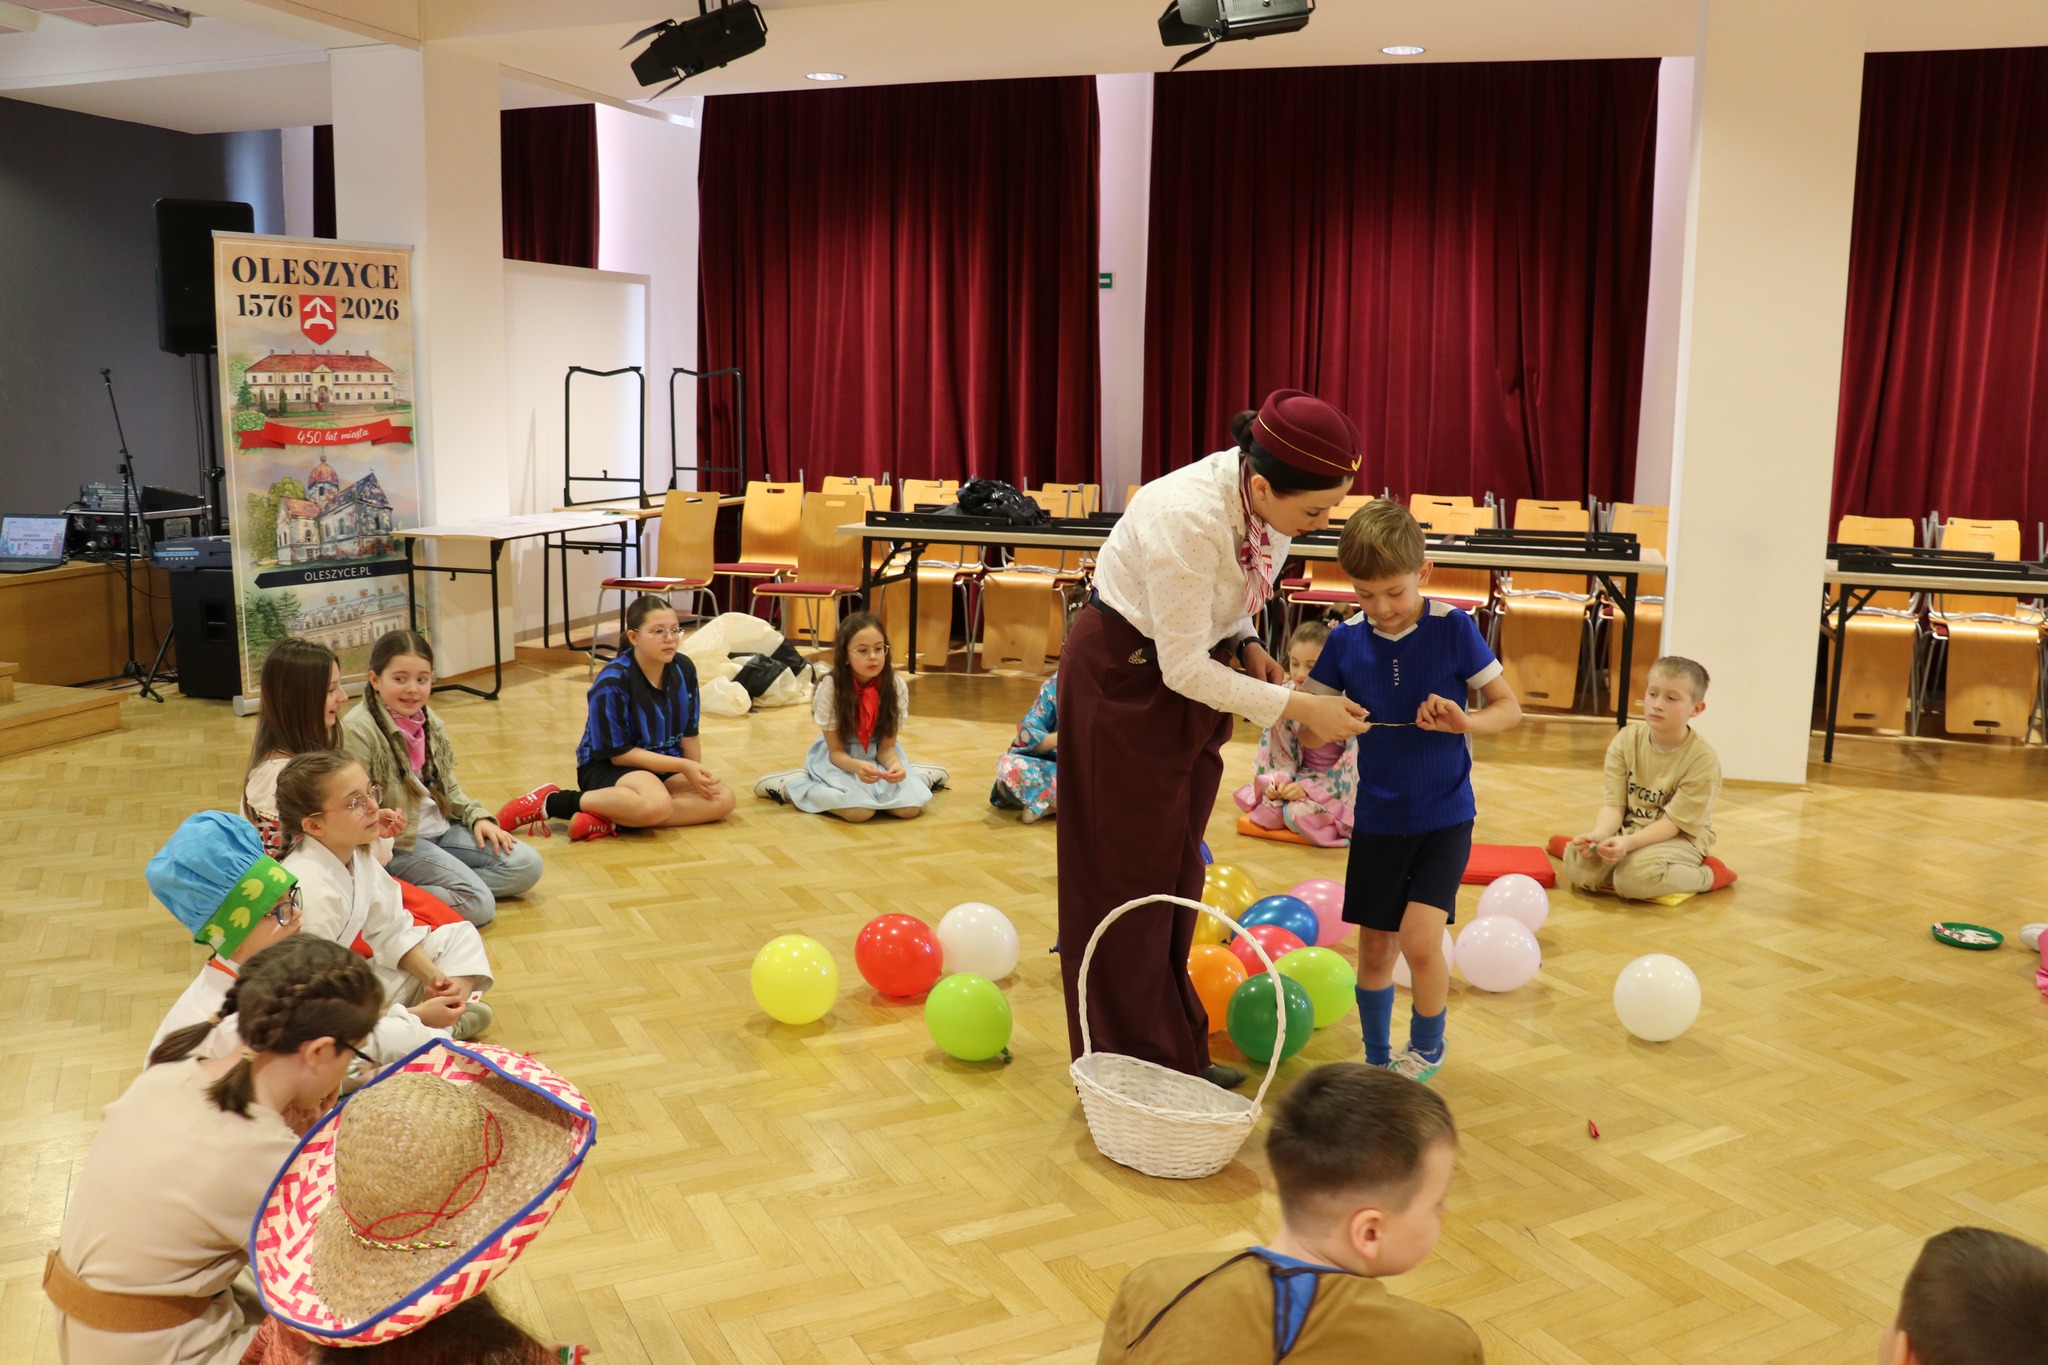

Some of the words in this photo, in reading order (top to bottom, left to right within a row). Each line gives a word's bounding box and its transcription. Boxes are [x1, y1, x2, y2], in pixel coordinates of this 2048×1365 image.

[232, 255, 399, 290] OLESZYCE
[236, 293, 293, 318] 1576
[341, 296, 399, 321] 2026
[297, 430, 322, 444] 450
[325, 431, 338, 442] lat
[341, 428, 369, 440] miasta
[304, 566, 372, 582] OLESZYCE.PL
[1392, 659, 1400, 686] KIPSTA
